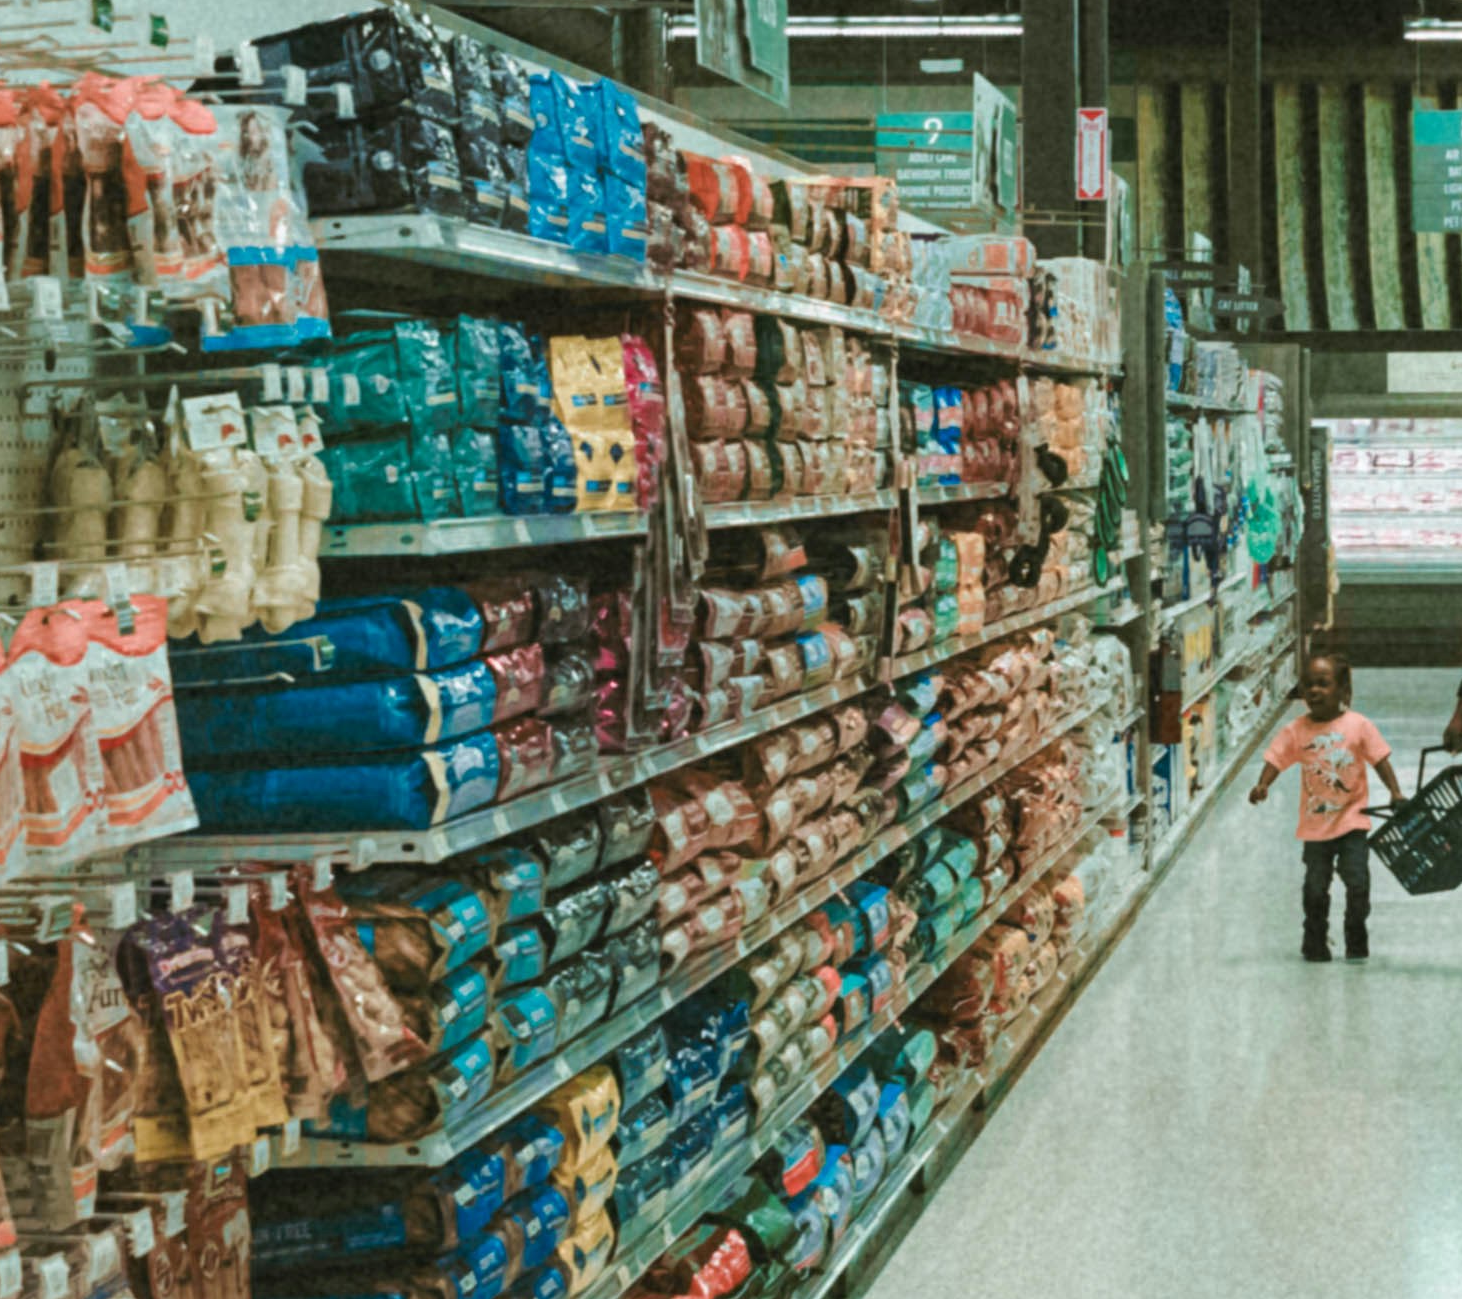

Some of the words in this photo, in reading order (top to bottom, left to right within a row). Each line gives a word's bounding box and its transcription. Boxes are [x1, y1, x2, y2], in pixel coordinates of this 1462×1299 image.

[923, 117, 943, 145] 9
[1445, 148, 1460, 160] AIR
[1444, 217, 1459, 228] PET
